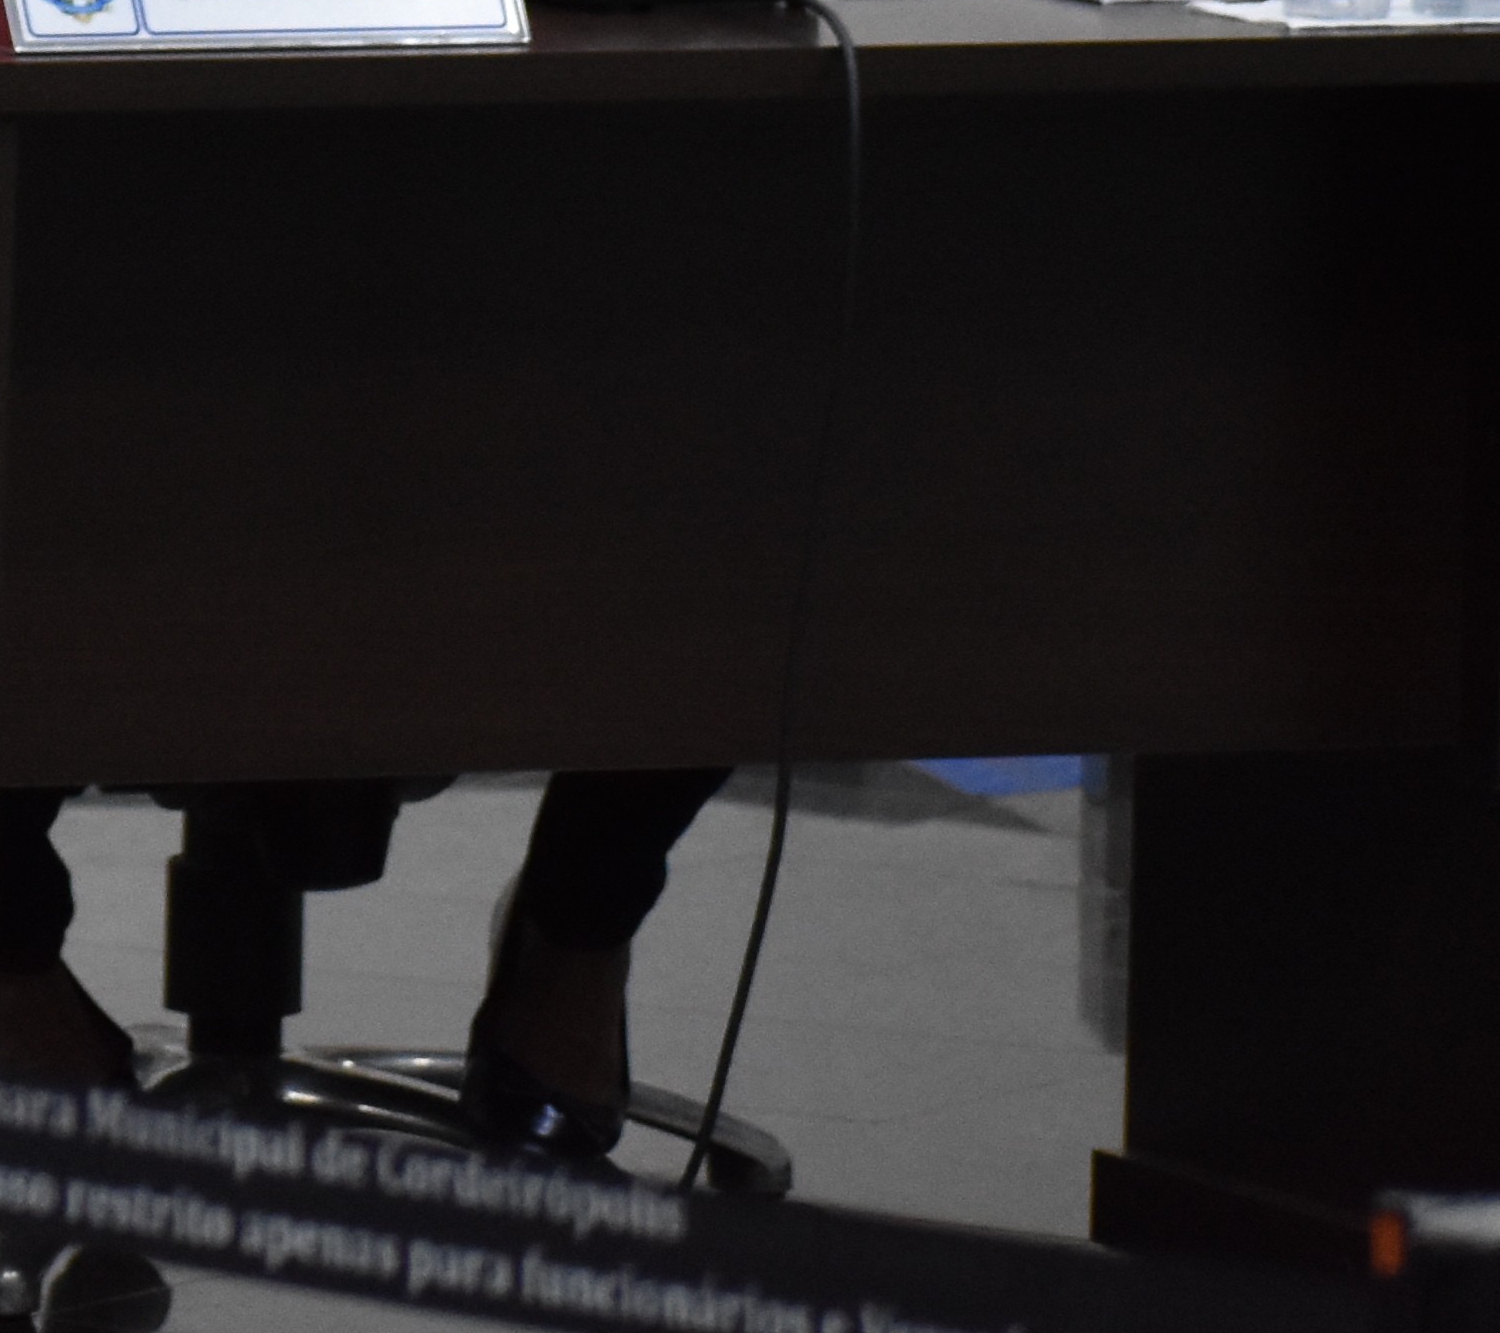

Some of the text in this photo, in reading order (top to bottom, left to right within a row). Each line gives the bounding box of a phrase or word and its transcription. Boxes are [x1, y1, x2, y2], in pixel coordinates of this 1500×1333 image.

[86, 1088, 305, 1180] Municipal
[310, 1127, 369, 1188] de
[377, 1136, 689, 1241] Cordeirópolis
[65, 1177, 237, 1250] restrito
[239, 1209, 399, 1277] apenas
[407, 1238, 514, 1300] para
